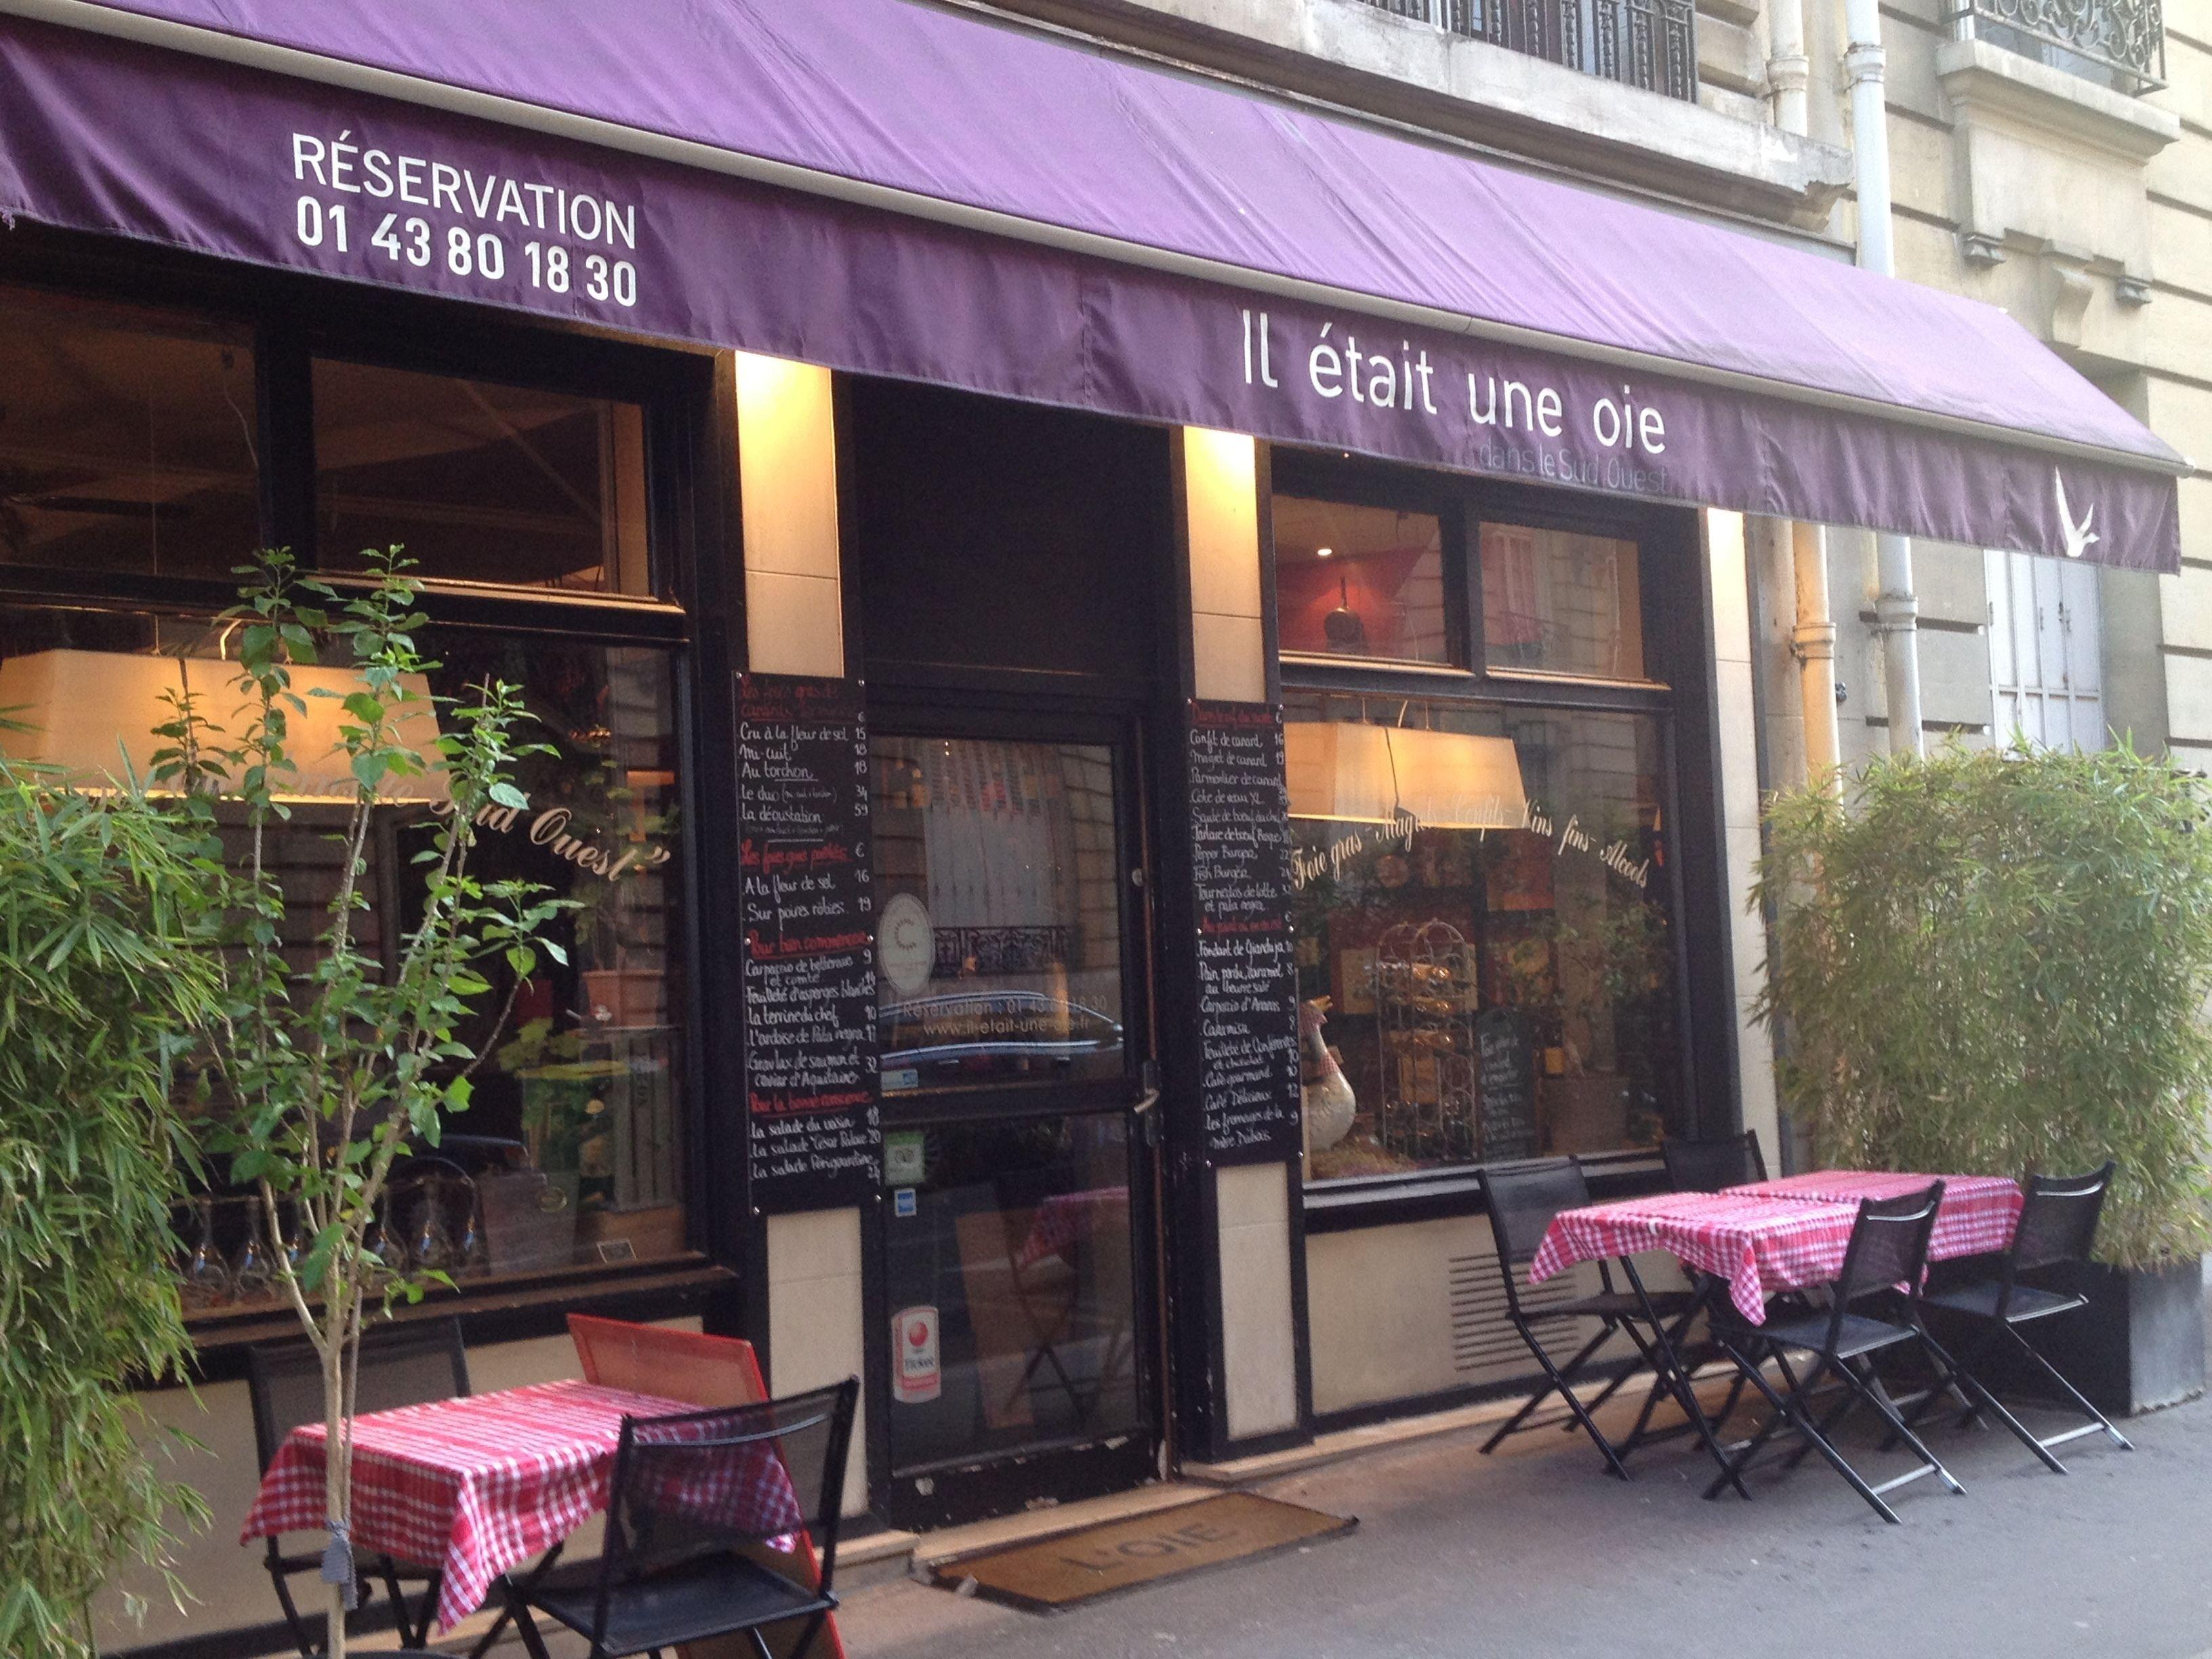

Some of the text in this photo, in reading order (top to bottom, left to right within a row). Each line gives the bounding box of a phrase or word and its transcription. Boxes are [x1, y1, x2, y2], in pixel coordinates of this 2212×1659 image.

[293, 130, 635, 249] RÉSERVATION
[298, 196, 636, 307] 01 43 80 18 30
[1244, 310, 1665, 454] Il était une oie
[1480, 438, 1535, 472] dans
[1540, 444, 1555, 476] le
[1559, 449, 1598, 484] Sud
[740, 721, 761, 741] Cru
[775, 724, 789, 740] la
[790, 724, 817, 752] fleur
[819, 724, 832, 740] de
[833, 724, 849, 741] sel
[855, 726, 866, 740] 15
[1189, 729, 1218, 754] Confit
[1221, 732, 1231, 747] de
[741, 762, 760, 779] Au
[741, 784, 754, 800] Le
[741, 803, 755, 821] La
[1292, 847, 1327, 891] Foie
[1330, 829, 1363, 882] gras
[756, 876, 770, 895] la
[801, 874, 815, 890] de
[817, 873, 836, 889] sel
[747, 902, 773, 922] Sur
[796, 958, 808, 973] de
[862, 949, 872, 964] 9
